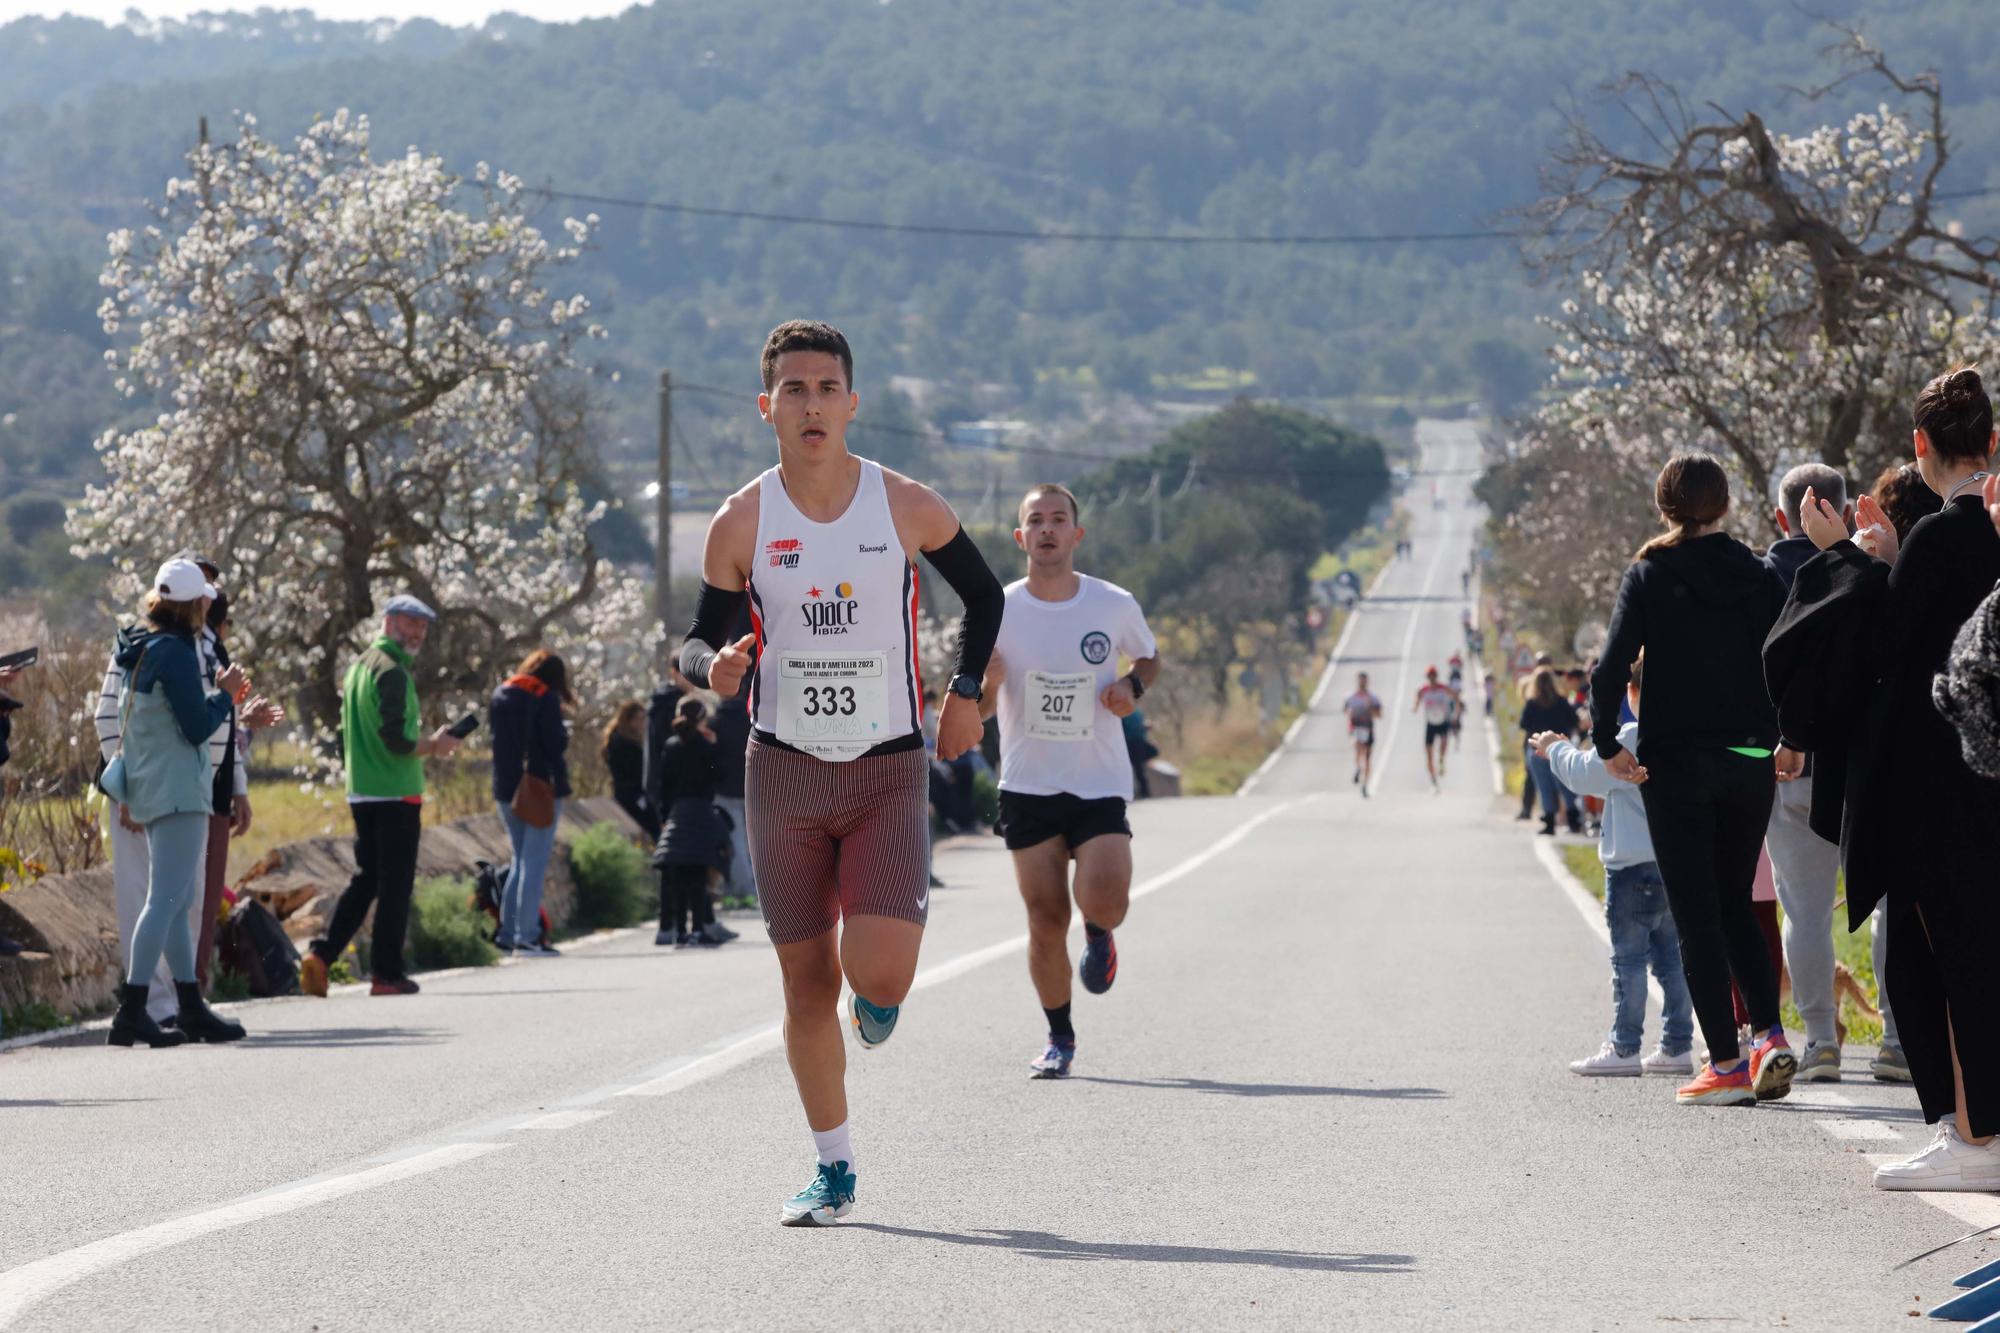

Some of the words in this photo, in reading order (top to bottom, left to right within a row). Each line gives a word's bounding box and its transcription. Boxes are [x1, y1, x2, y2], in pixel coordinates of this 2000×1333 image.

[801, 600, 859, 635] space
[818, 627, 848, 635] IBIZA
[788, 660, 806, 669] CURSA
[807, 661, 821, 669] FLOR
[858, 660, 874, 668] 2023
[803, 686, 857, 716] 333
[1041, 694, 1075, 713] 207
